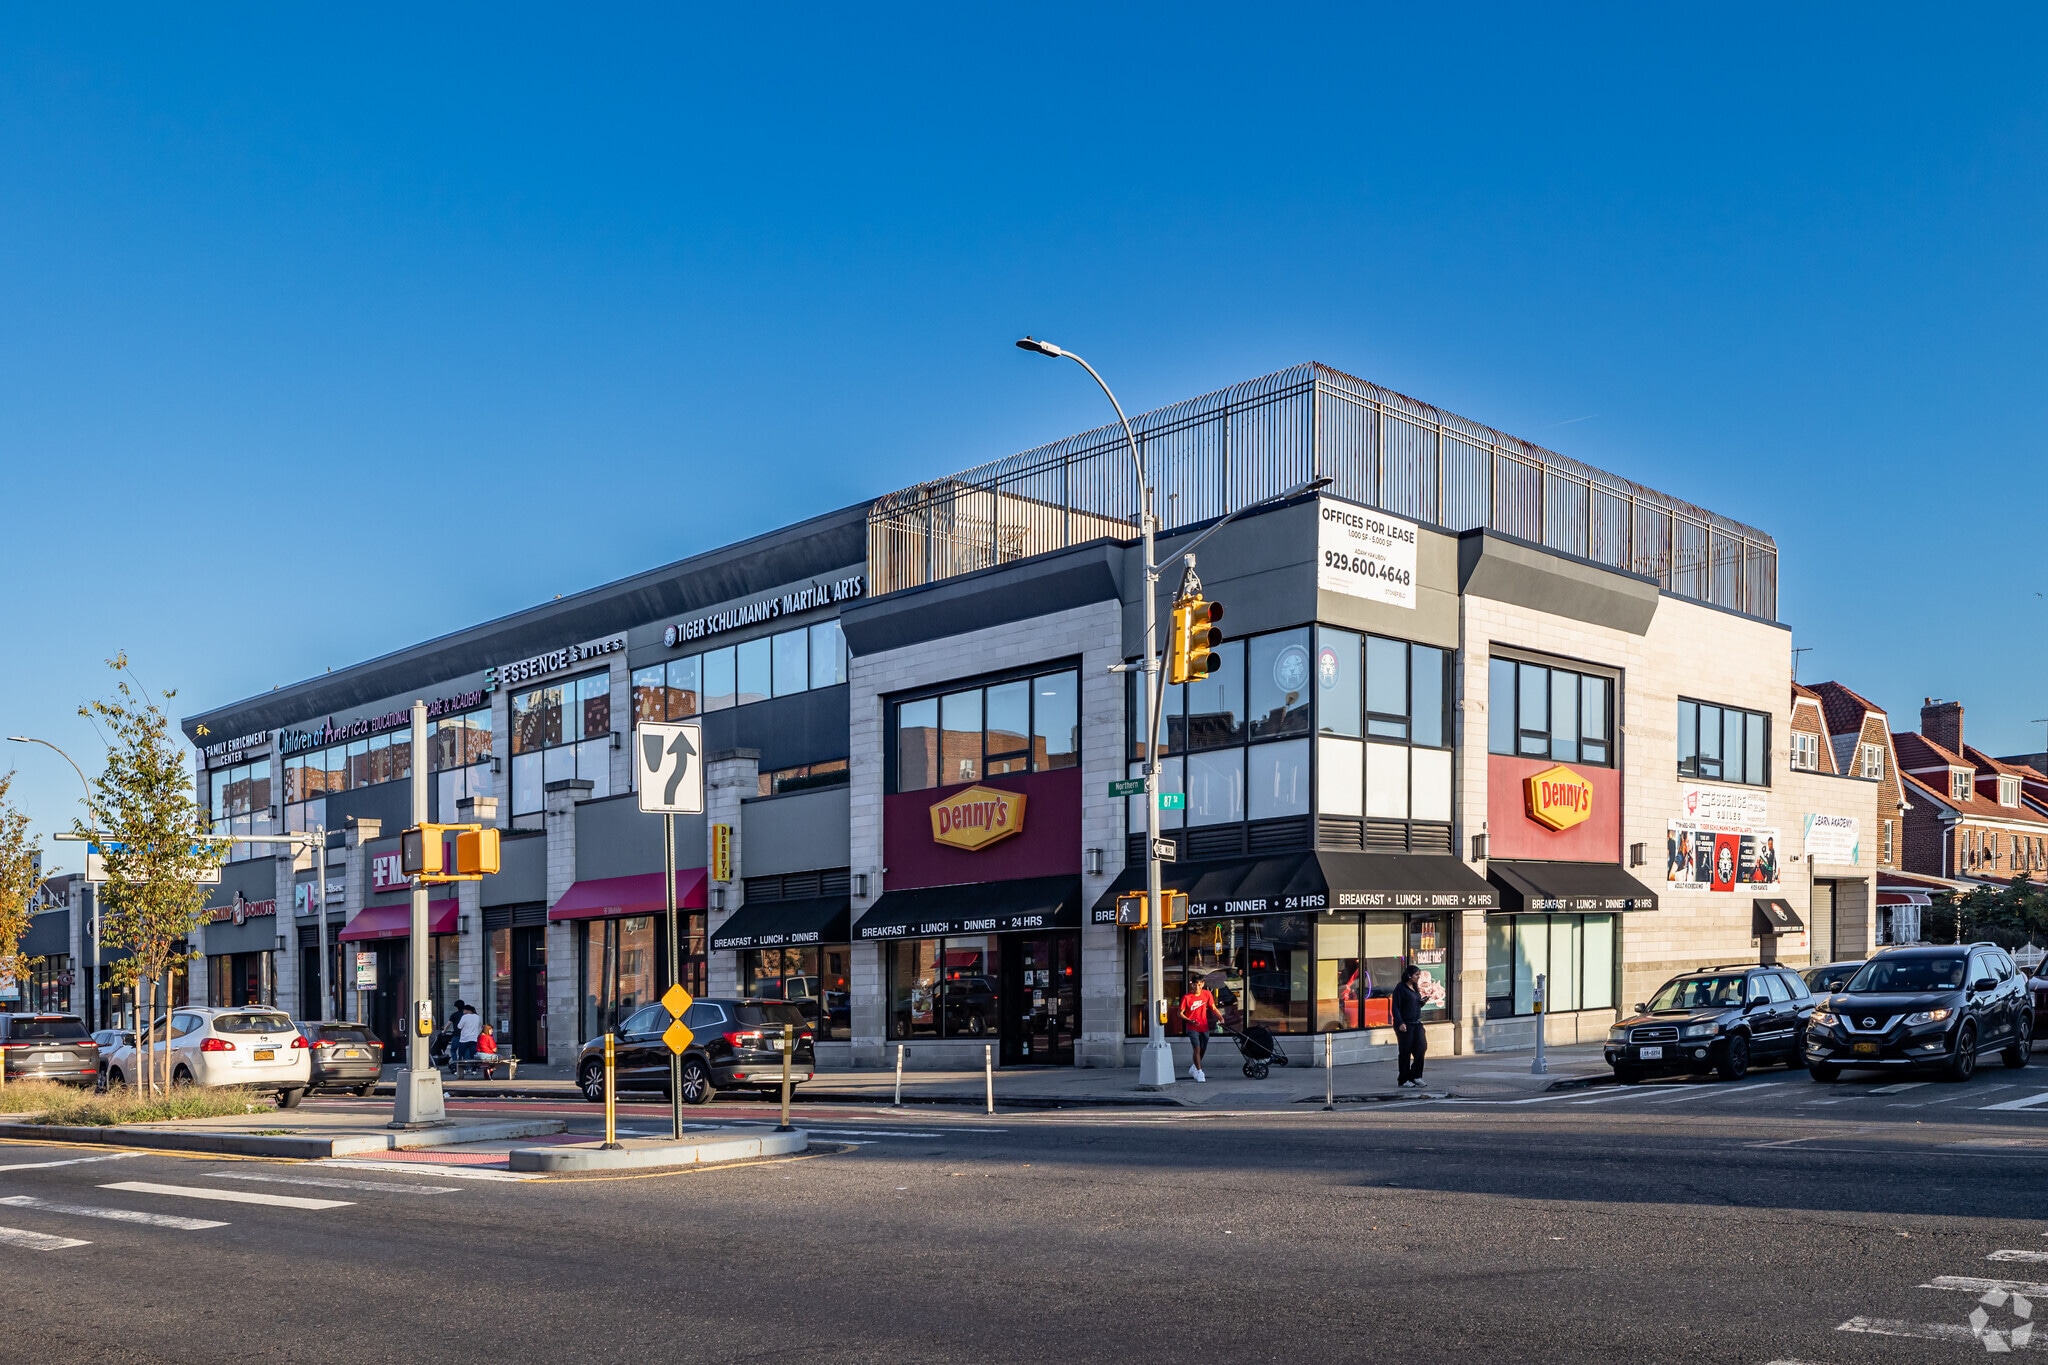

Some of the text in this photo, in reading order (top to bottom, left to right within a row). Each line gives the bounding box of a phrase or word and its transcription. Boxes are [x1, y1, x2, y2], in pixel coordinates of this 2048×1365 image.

[1322, 507, 1415, 544] OFFICES FOR LEASE
[1348, 529, 1361, 539] 1,000
[1362, 533, 1368, 541] SF
[1325, 549, 1410, 587] 929.600.4648
[677, 575, 861, 643] TIGER SCHULMANN'S MARTIAL ARTS
[502, 638, 621, 684] ESSENCE SMILES
[278, 727, 312, 755] Children
[313, 723, 325, 746] of
[324, 715, 369, 744] America
[371, 709, 410, 732] EDUCATIONAL
[444, 698, 451, 713] &
[451, 690, 482, 711] ACADEMY
[206, 730, 267, 758] FAMILY ENRICHMENT
[220, 751, 243, 766] CENTER
[1115, 781, 1139, 791] Northern
[1163, 795, 1172, 808] 87
[1541, 781, 1589, 812] Denny's
[937, 797, 1008, 836] Denny's
[244, 898, 276, 918] DONUTS
[1187, 903, 1207, 915] NCH
[1225, 899, 1267, 913] DINNER
[1285, 897, 1298, 908] 24
[1300, 895, 1325, 907] HRS
[1339, 893, 1492, 906] BREAKFAST LUNCH DINNER 24 HRS
[1532, 899, 1652, 909] BREAKFAST LUNCH DINNER 24 HRS
[862, 915, 1043, 938] BREAKFAST LUNCH DINNER 24 HRS
[714, 931, 819, 948] BREAKFAST LUNCH DINNER
[1026, 972, 1032, 981] A
